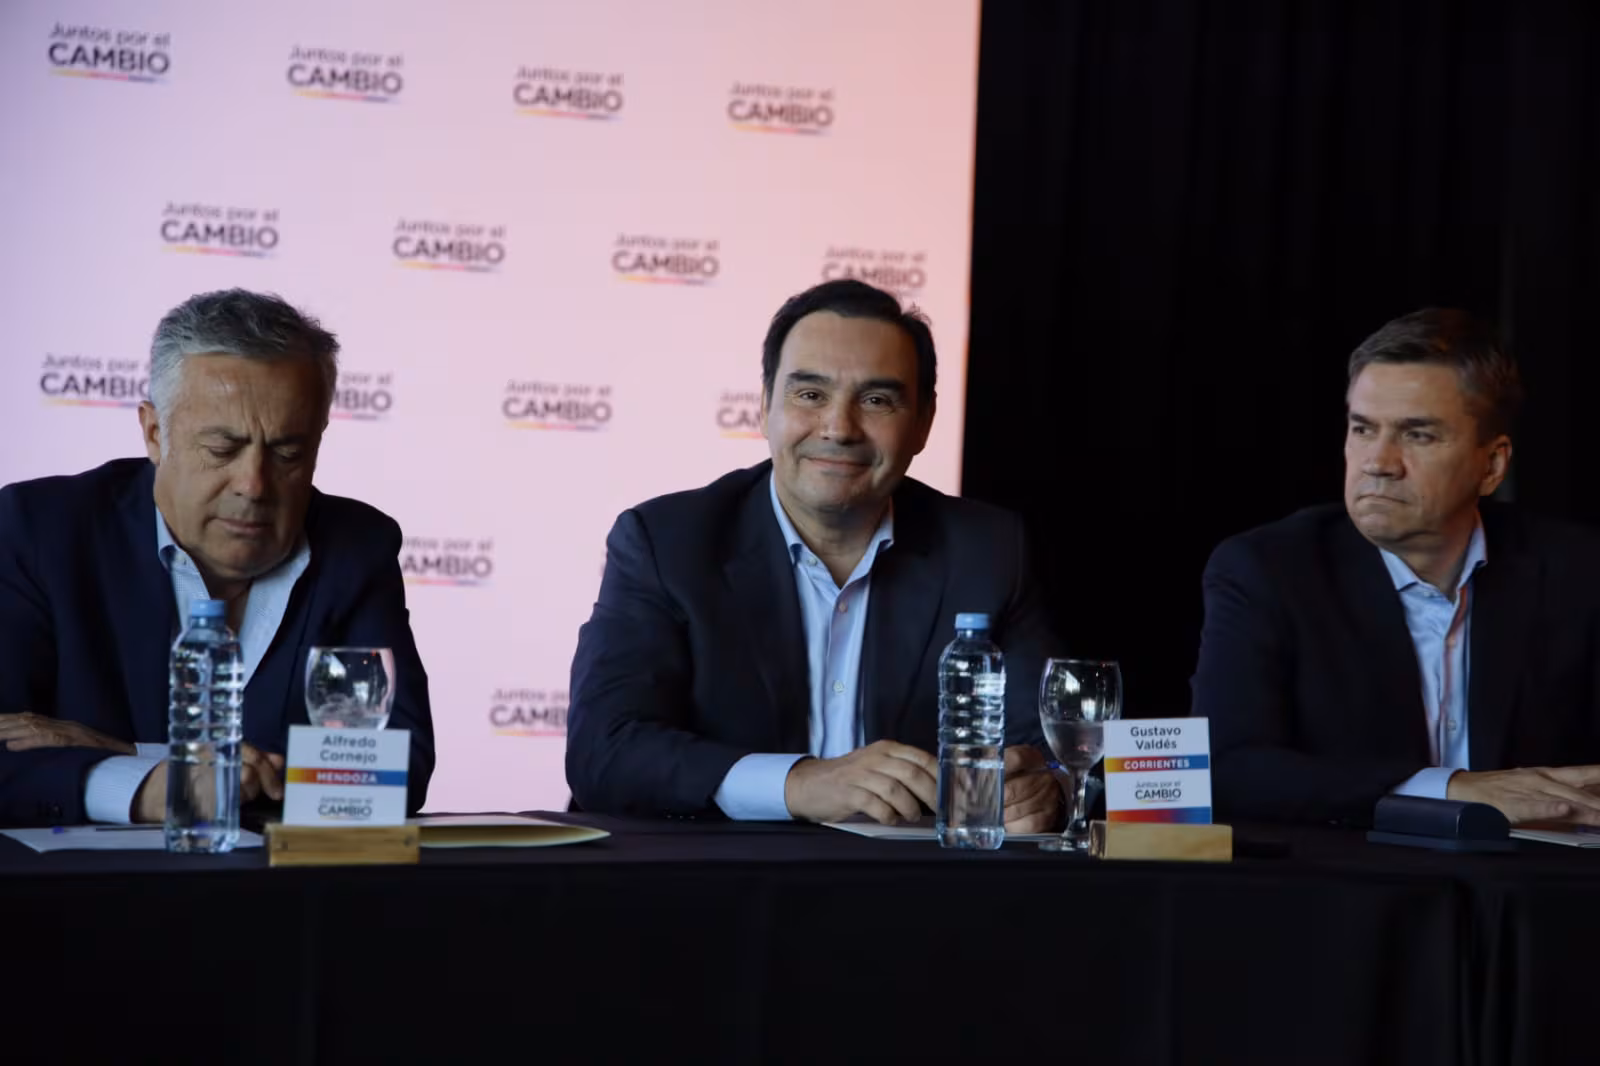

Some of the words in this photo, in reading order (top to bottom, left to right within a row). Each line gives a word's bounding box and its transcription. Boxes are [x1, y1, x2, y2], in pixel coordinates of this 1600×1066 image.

[49, 22, 110, 43] Juntos
[117, 30, 147, 47] por
[153, 32, 170, 46] el
[48, 42, 170, 75] CAMBIO
[289, 46, 347, 64] Juntos
[353, 53, 382, 69] por
[387, 53, 403, 67] el
[287, 64, 404, 95] CAMBIO
[515, 67, 569, 82] Juntos
[575, 73, 602, 87] por
[513, 83, 623, 113] CAMBIO
[730, 83, 782, 98] Juntos
[787, 88, 813, 102] por
[728, 99, 834, 128] CAMBIO
[162, 202, 221, 219] Juntos
[228, 207, 257, 224] por
[263, 208, 279, 222] el
[161, 219, 279, 249] CAMBIO
[395, 220, 450, 235] Juntos
[456, 224, 484, 239] por
[392, 236, 505, 265] CAMBIO
[615, 234, 668, 249] Juntos
[673, 239, 698, 253] por
[612, 250, 719, 278] CAMBIO
[41, 352, 103, 369] Juntos
[107, 359, 139, 373] por
[342, 371, 372, 386] por
[505, 379, 559, 395] Juntos
[565, 384, 592, 398] por
[502, 396, 612, 423] CAMBIO
[444, 539, 472, 553] por
[402, 555, 493, 578] AMBIO
[492, 688, 546, 701] Juntos
[489, 703, 567, 728] CAMB
[1130, 726, 1181, 737] Gustavo
[322, 735, 377, 748] Alfredo
[1135, 738, 1177, 750] Valdés
[319, 749, 378, 764] Cornejo
[1124, 758, 1190, 770] CORRIENTES
[316, 772, 378, 784] MENDOZA
[1135, 788, 1181, 799] CAMBIO
[318, 804, 373, 817] CAMBIO
